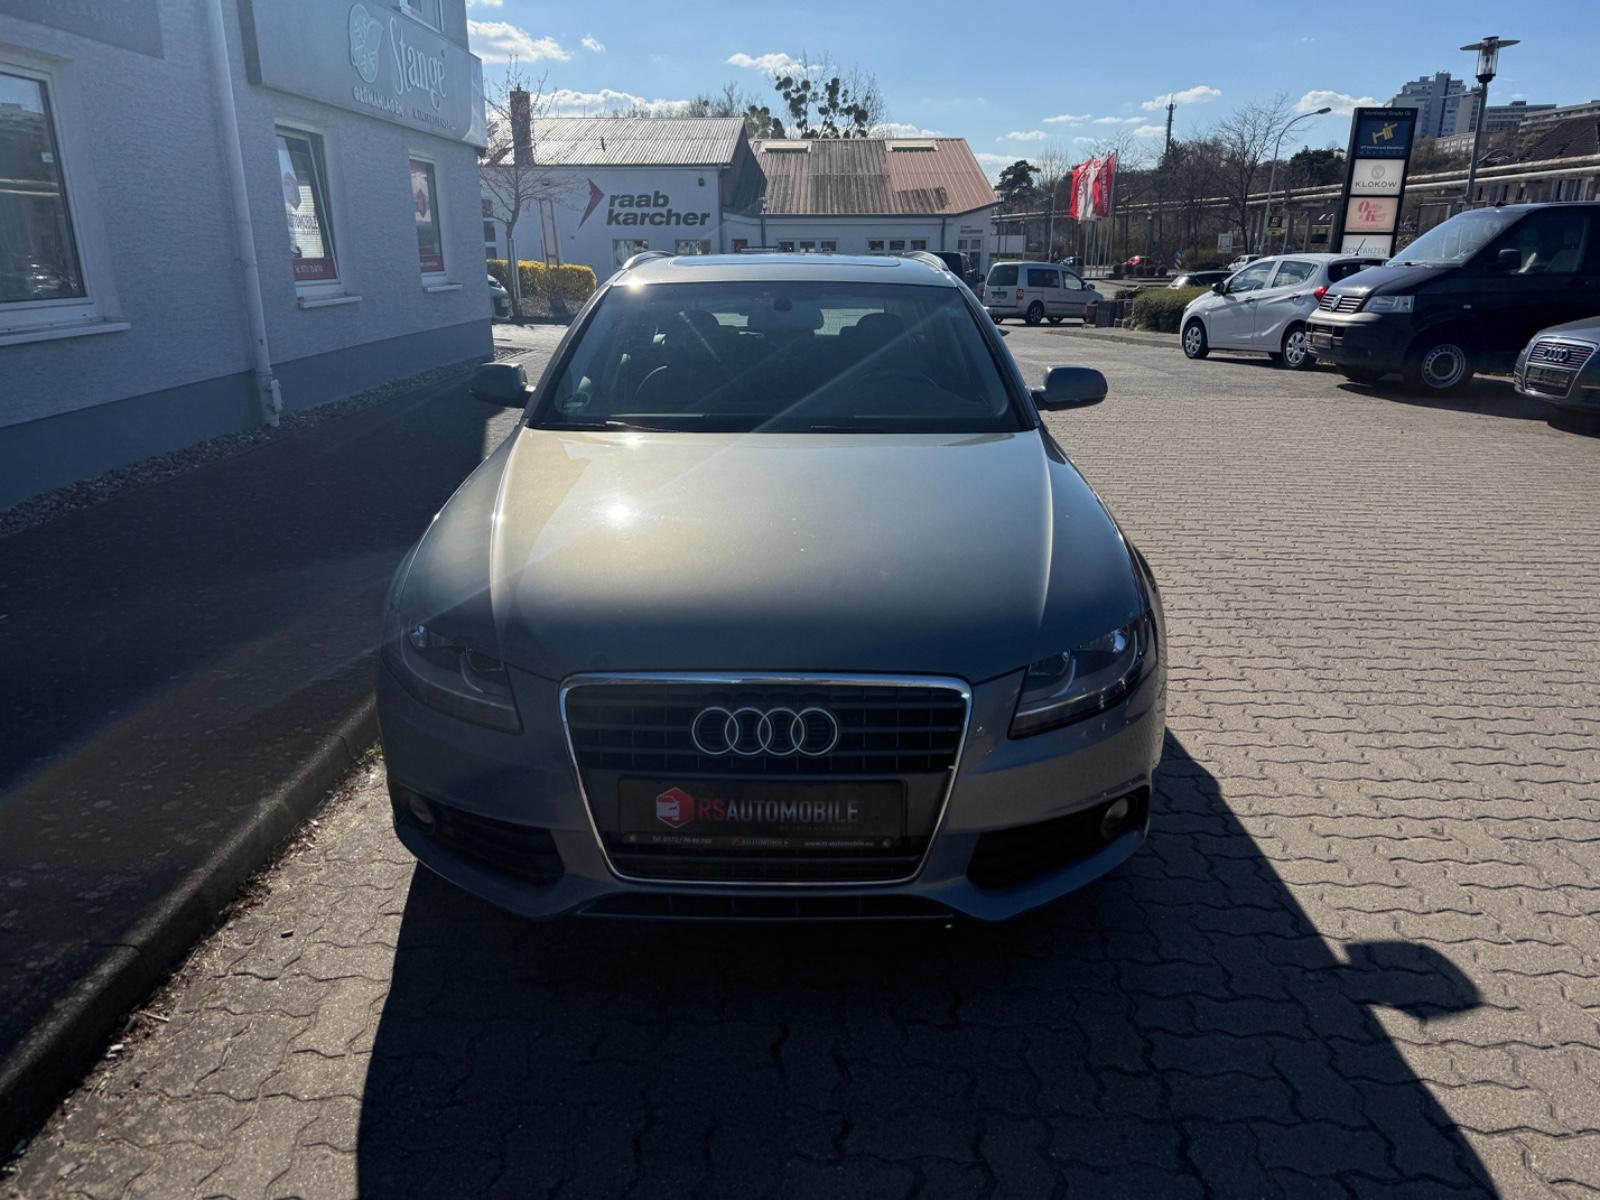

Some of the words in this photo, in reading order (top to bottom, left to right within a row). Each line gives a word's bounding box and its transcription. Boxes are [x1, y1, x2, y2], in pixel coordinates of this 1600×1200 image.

[389, 16, 448, 111] Stange
[609, 190, 669, 208] raab
[607, 209, 711, 226] karcher
